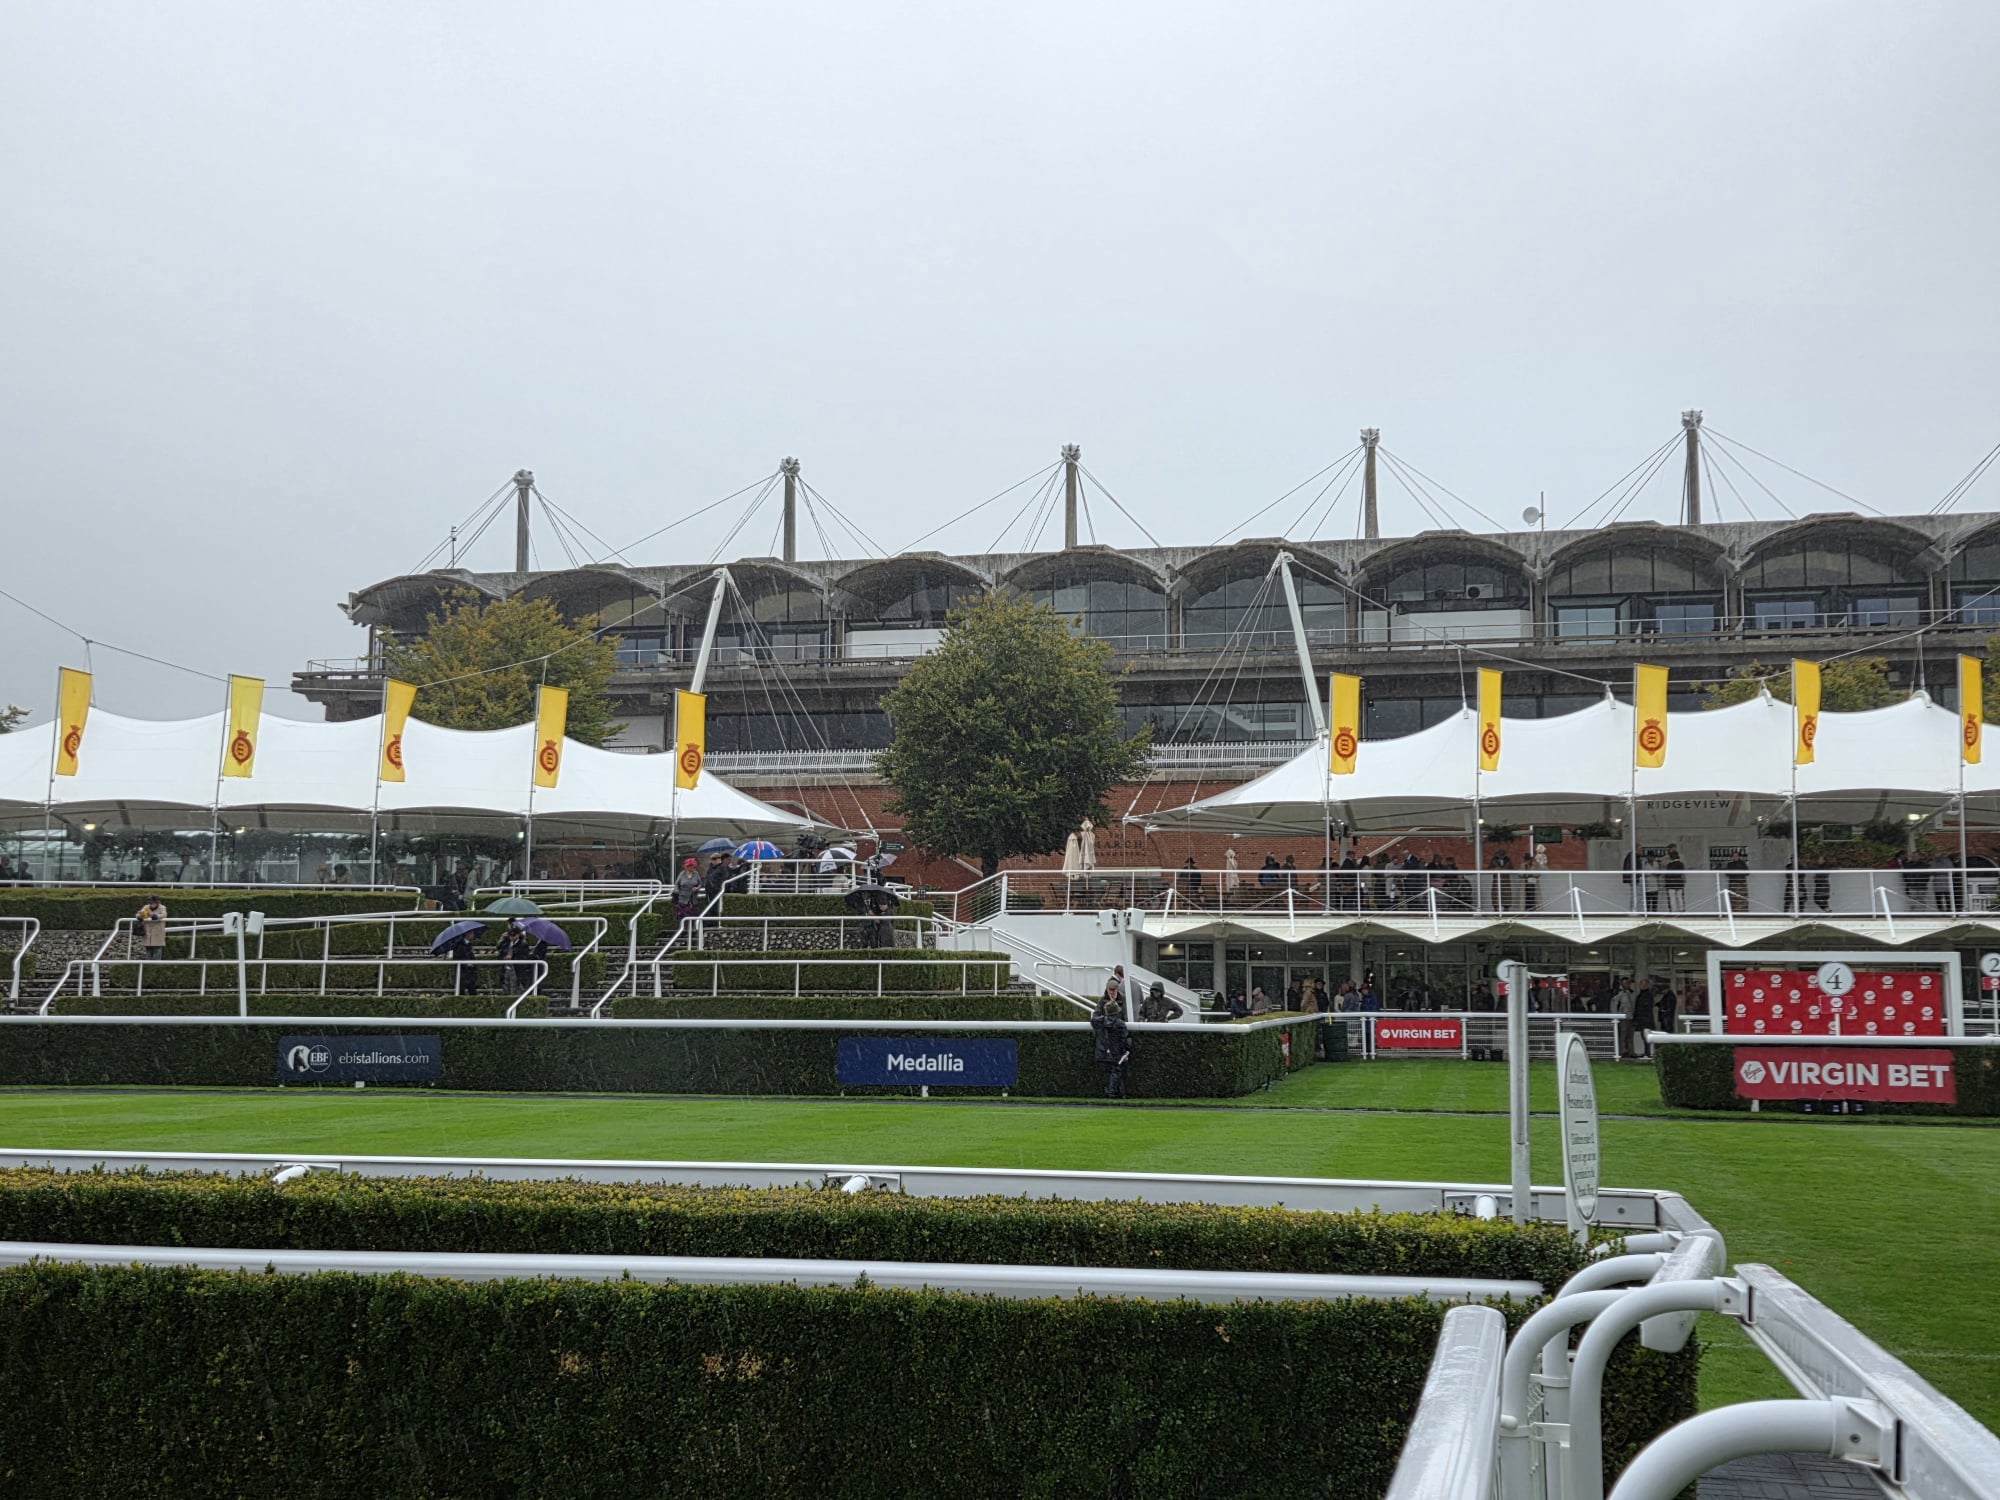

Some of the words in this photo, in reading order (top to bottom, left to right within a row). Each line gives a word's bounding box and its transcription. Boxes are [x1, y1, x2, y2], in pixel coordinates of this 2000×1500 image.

[1647, 800, 1730, 809] RIDGEVIEW
[1989, 958, 2000, 972] 2
[1826, 967, 1843, 989] 4
[1391, 1029, 1432, 1038] VIRGIN
[1434, 1029, 1457, 1039] BET
[310, 1052, 329, 1062] EBF
[339, 1052, 429, 1064] ebfstallions.com
[887, 1053, 964, 1072] Medallia
[1767, 1061, 1879, 1086] VIRGIN
[1888, 1065, 1950, 1087] BET
